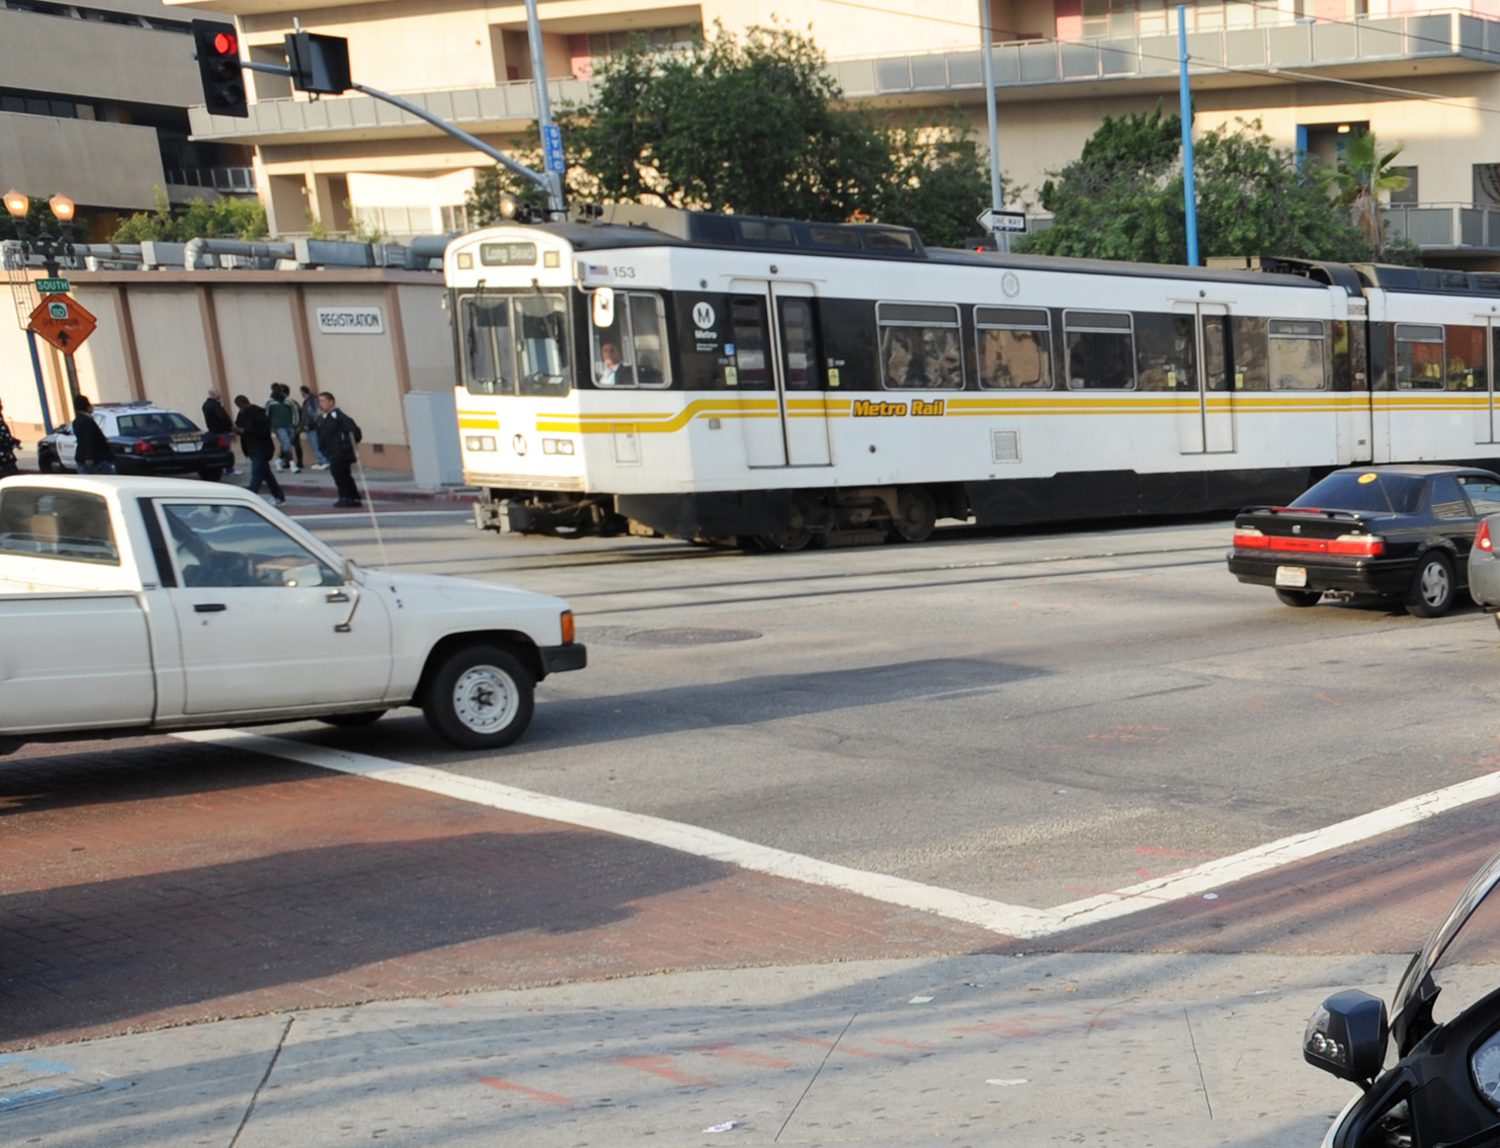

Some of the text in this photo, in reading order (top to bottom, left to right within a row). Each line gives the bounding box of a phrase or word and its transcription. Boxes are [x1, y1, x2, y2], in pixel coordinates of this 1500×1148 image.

[484, 245, 507, 264] Long
[612, 266, 636, 278] 153
[37, 281, 68, 290] SOUTH
[320, 312, 379, 327] REGISTRATION
[697, 307, 711, 323] M
[694, 329, 718, 340] Metro
[853, 399, 945, 417] Metro Rail
